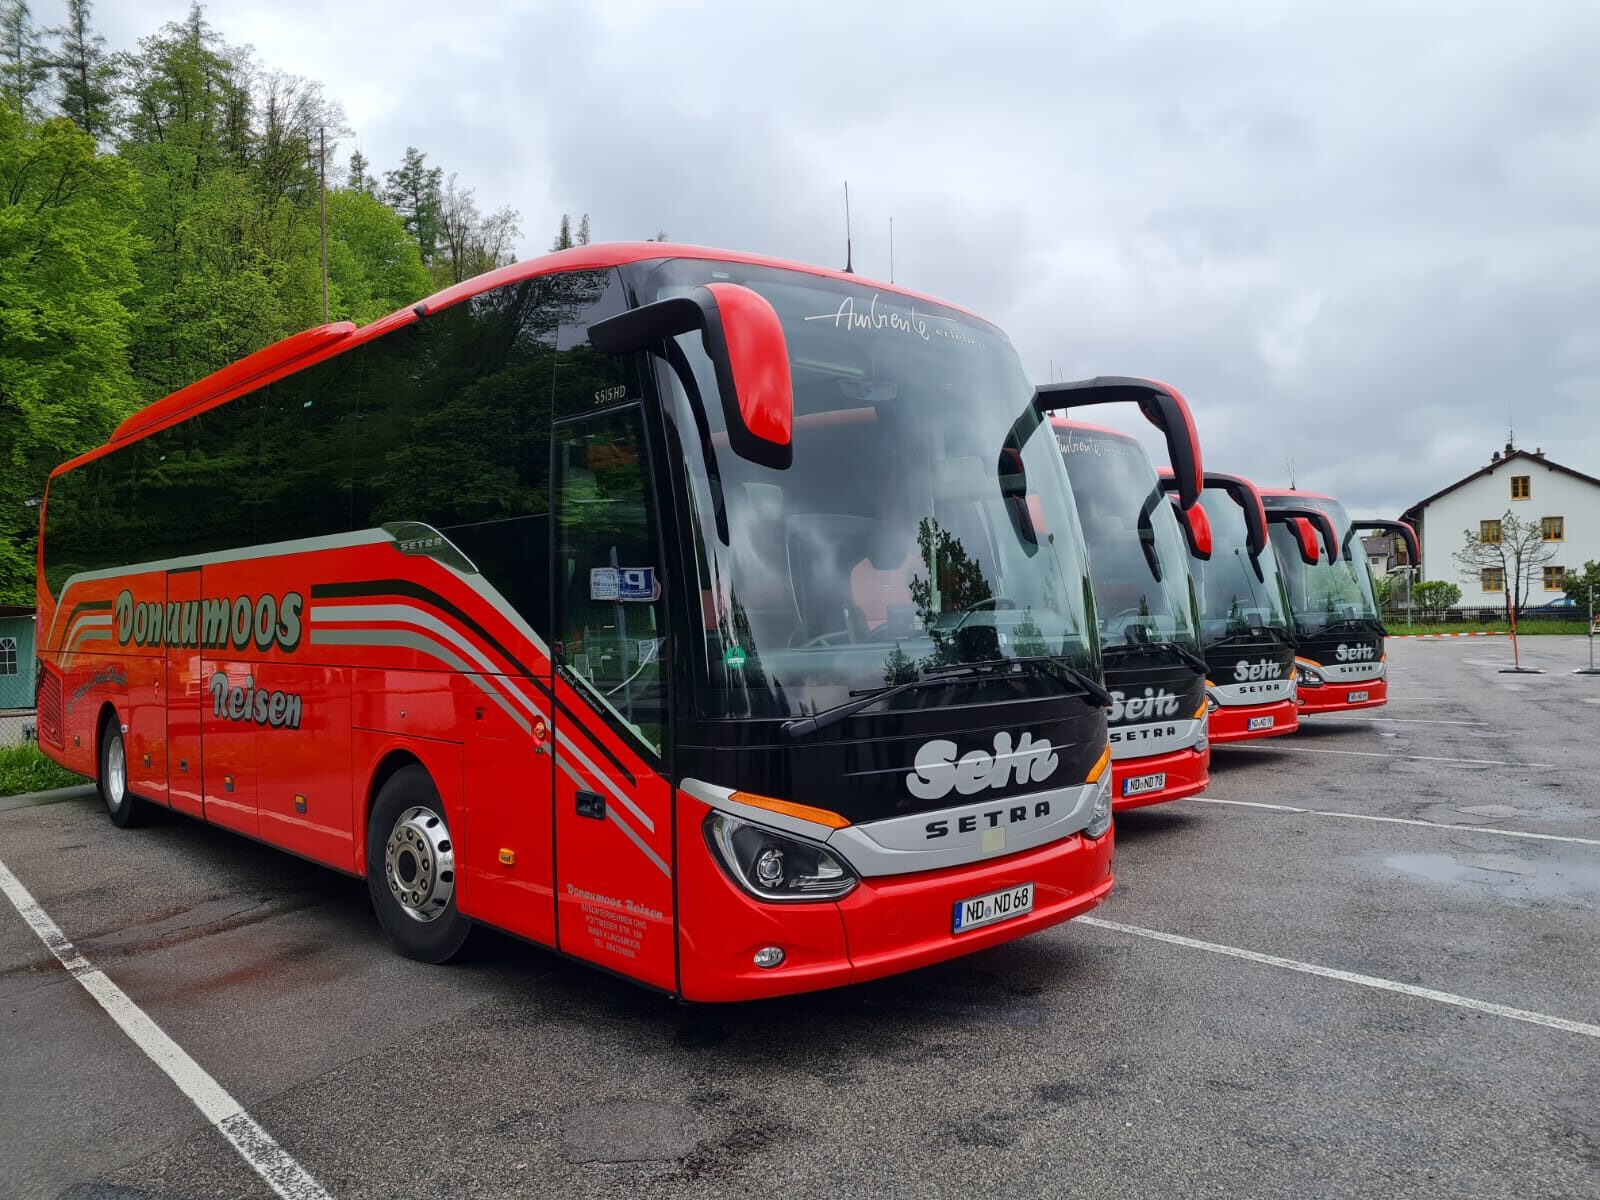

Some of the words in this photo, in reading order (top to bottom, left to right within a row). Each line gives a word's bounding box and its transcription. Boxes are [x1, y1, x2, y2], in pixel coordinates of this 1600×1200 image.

[804, 294, 956, 341] Ambiente
[400, 538, 442, 551] SETRA
[114, 589, 303, 652] Donaumoos
[1340, 665, 1373, 673] SETRA
[210, 671, 302, 730] Reisen
[1239, 683, 1280, 694] SETRA
[1109, 726, 1176, 743] SETRA
[1130, 779, 1140, 791] ND
[1144, 777, 1154, 789] ND
[1155, 774, 1163, 786] 78
[925, 801, 1050, 840] SETRA
[566, 883, 623, 908] Donaumoos
[625, 899, 664, 919] Reisen
[966, 900, 985, 923] ND
[993, 892, 1011, 916] ND
[1013, 887, 1029, 909] 68
